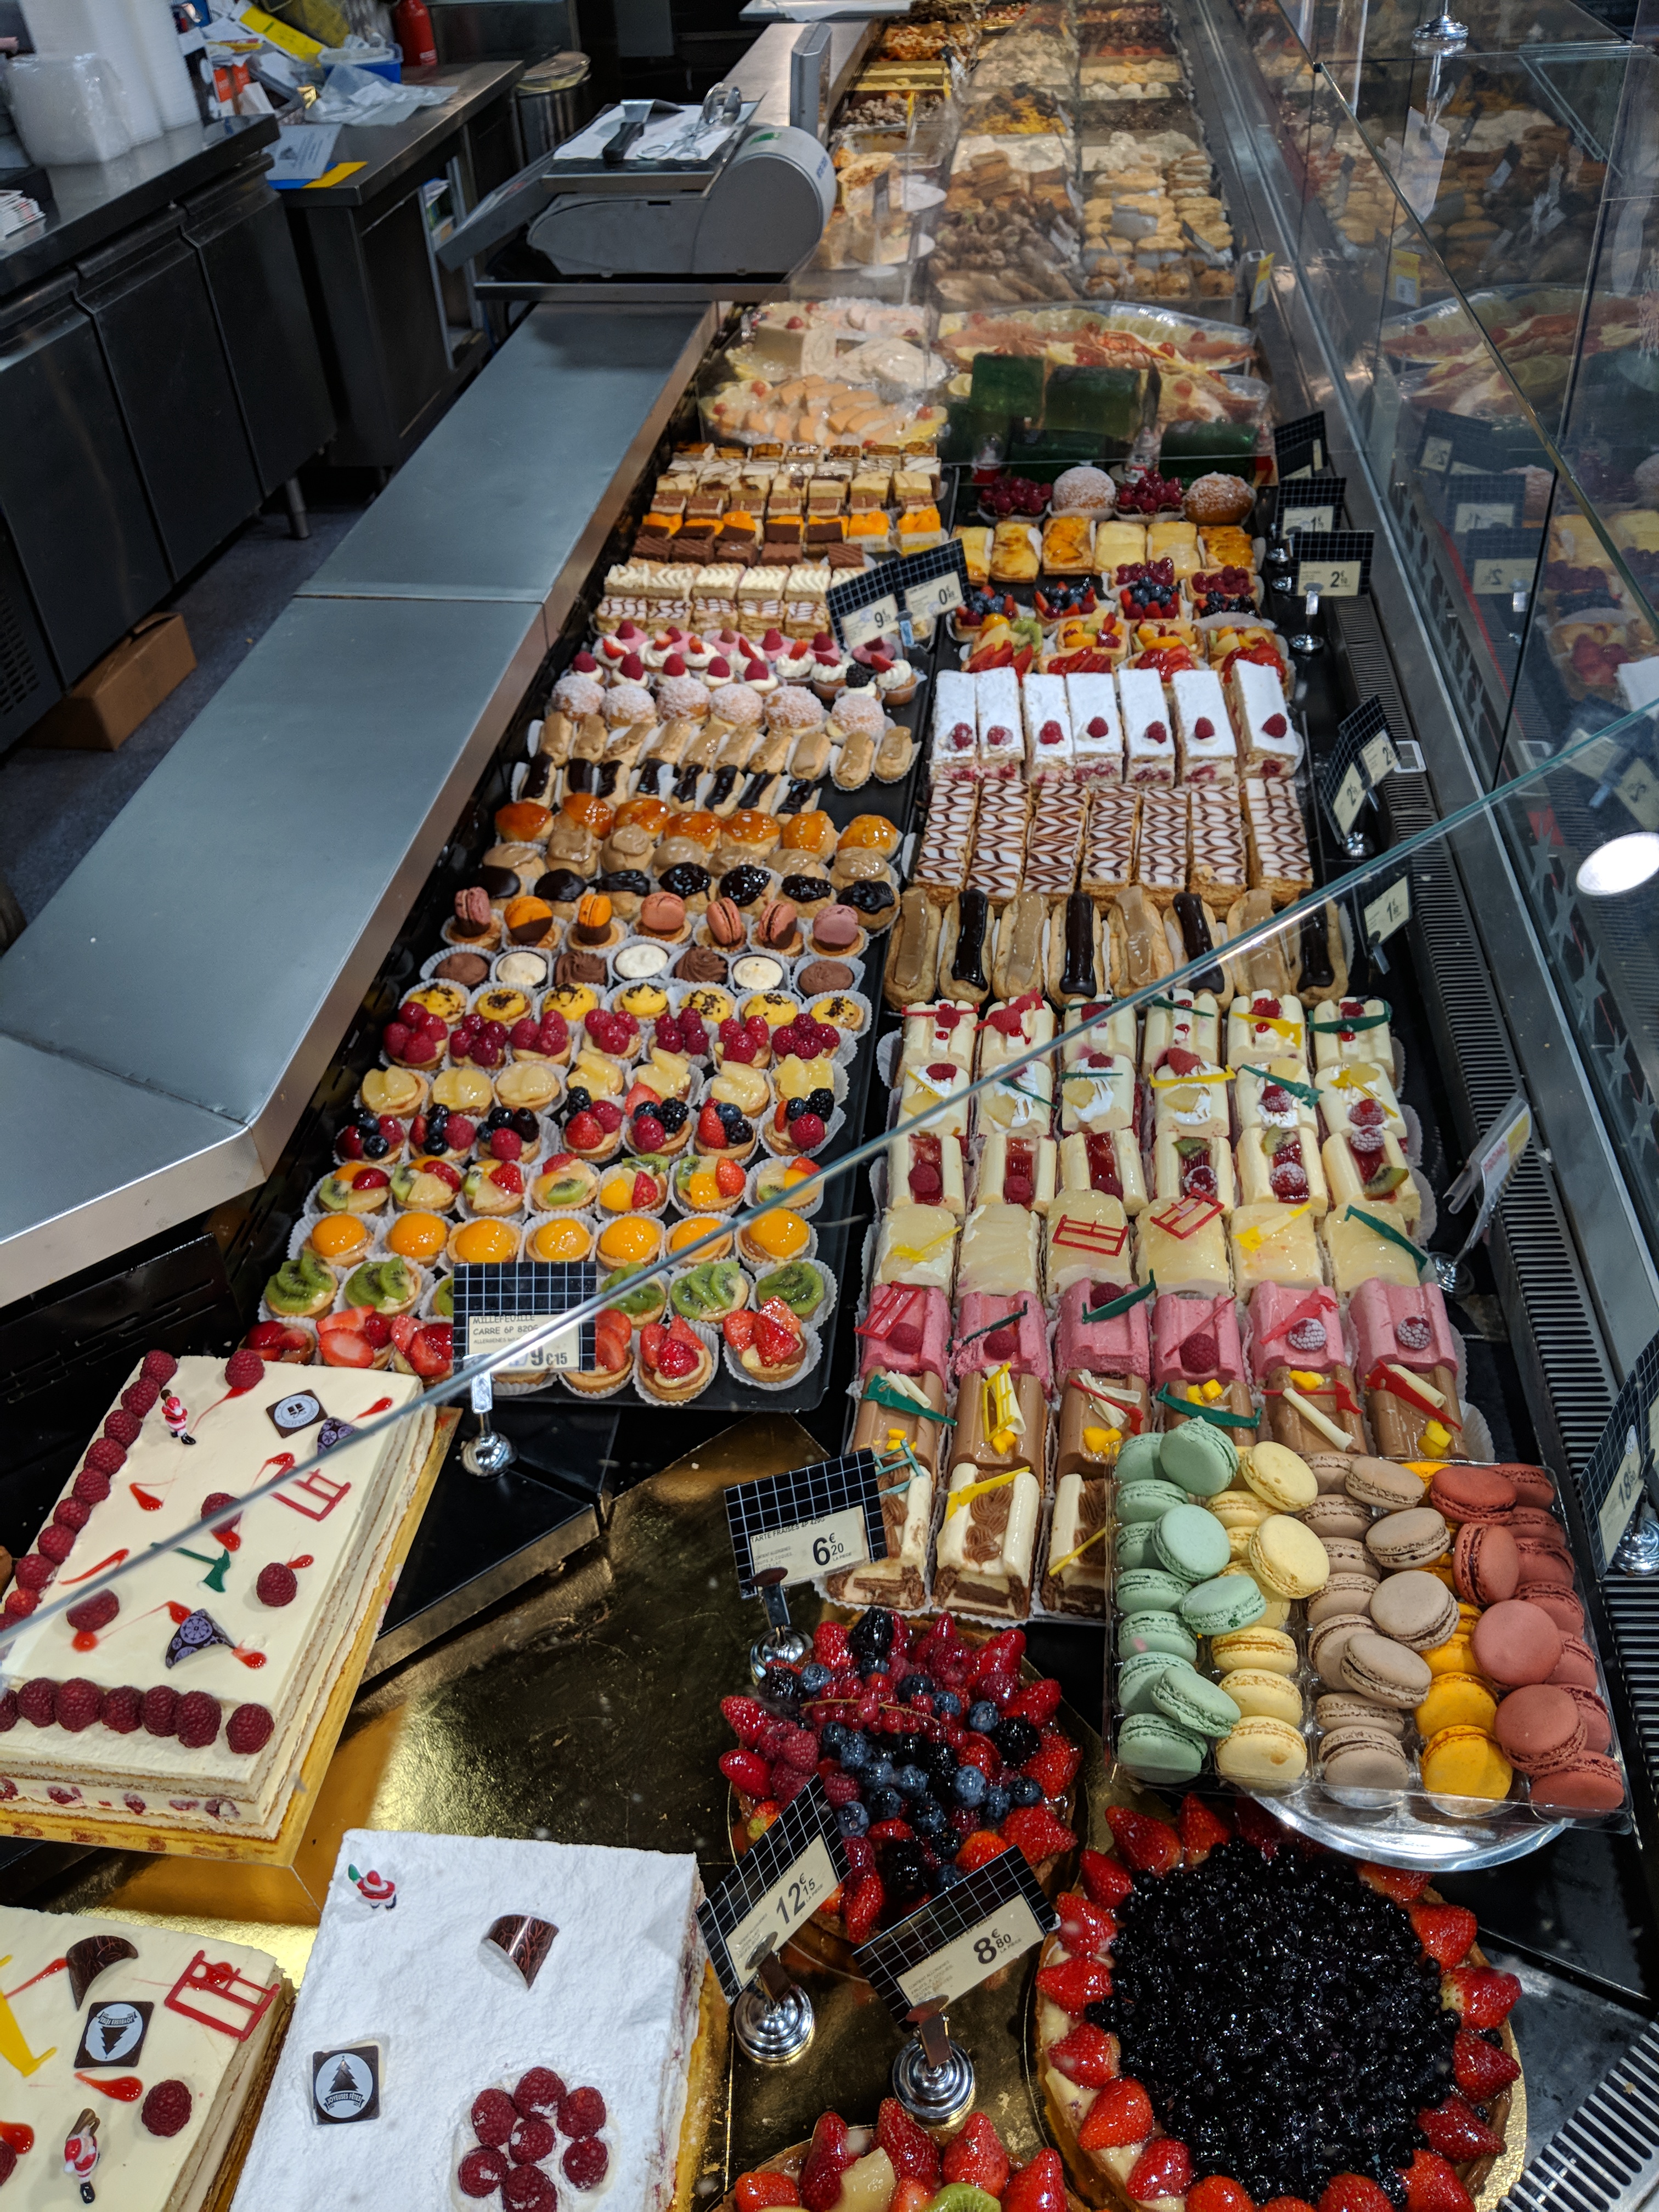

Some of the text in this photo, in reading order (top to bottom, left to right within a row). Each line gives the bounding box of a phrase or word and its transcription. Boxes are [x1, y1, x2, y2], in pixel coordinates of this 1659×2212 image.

[473, 1327, 500, 1336] CARRE
[751, 1533, 772, 1543] TARTE
[772, 1523, 800, 1537] FRAISES
[328, 2092, 362, 2104] JOYEUSES FÊTES
